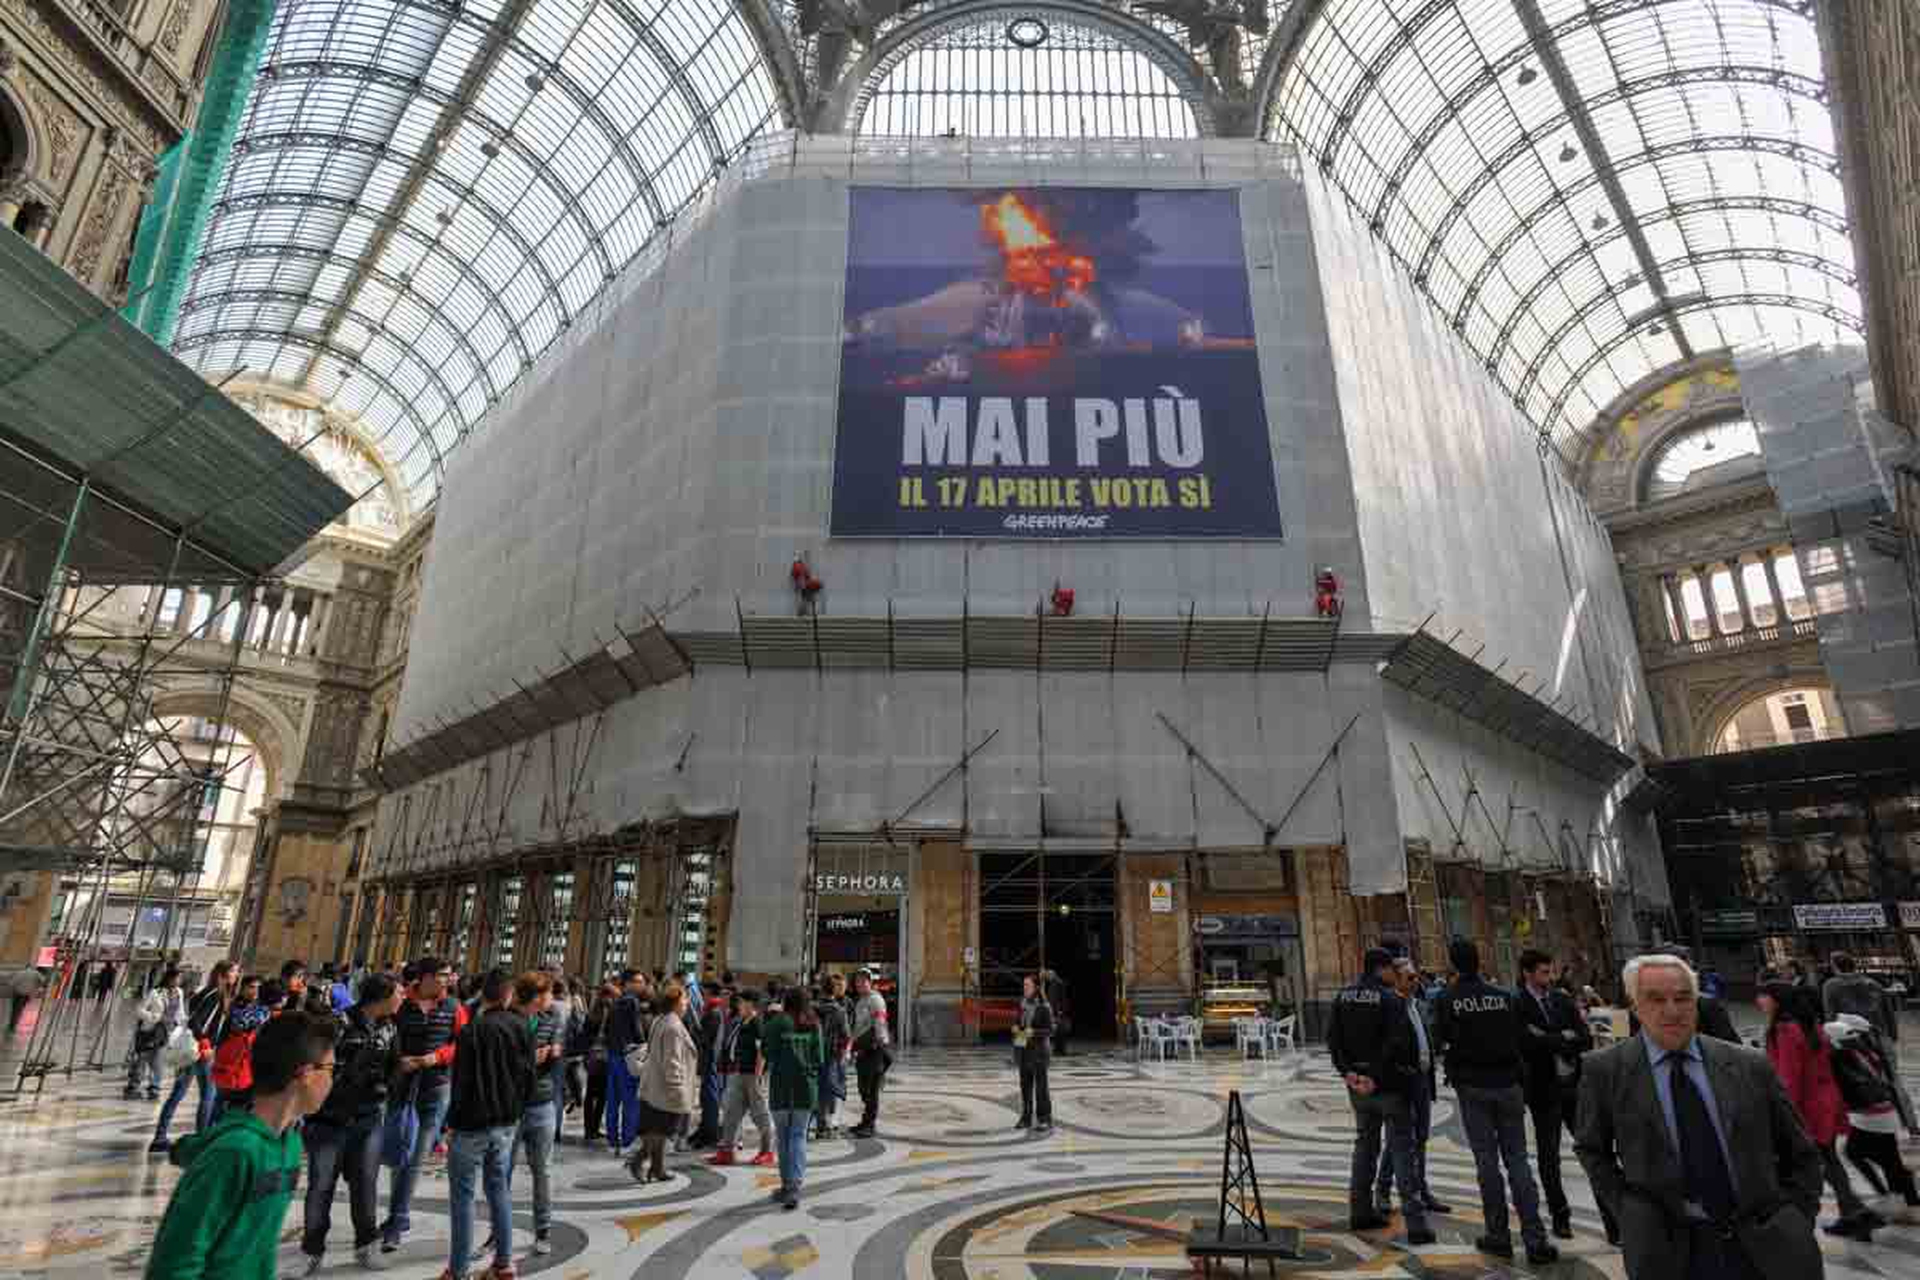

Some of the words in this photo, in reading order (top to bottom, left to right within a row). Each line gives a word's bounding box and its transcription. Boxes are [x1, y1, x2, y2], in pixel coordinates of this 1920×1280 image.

[901, 396, 1050, 468] MAI
[1074, 385, 1205, 468] PIÙ
[898, 477, 927, 507] IL
[936, 477, 968, 507] 17
[976, 477, 1083, 507] APRILE
[1090, 477, 1169, 507] VOTA
[1178, 474, 1211, 508] SÌ
[1003, 514, 1109, 529] GREENPEACE
[816, 876, 902, 889] SEPHORA
[1453, 998, 1508, 1013] POLIZIA
